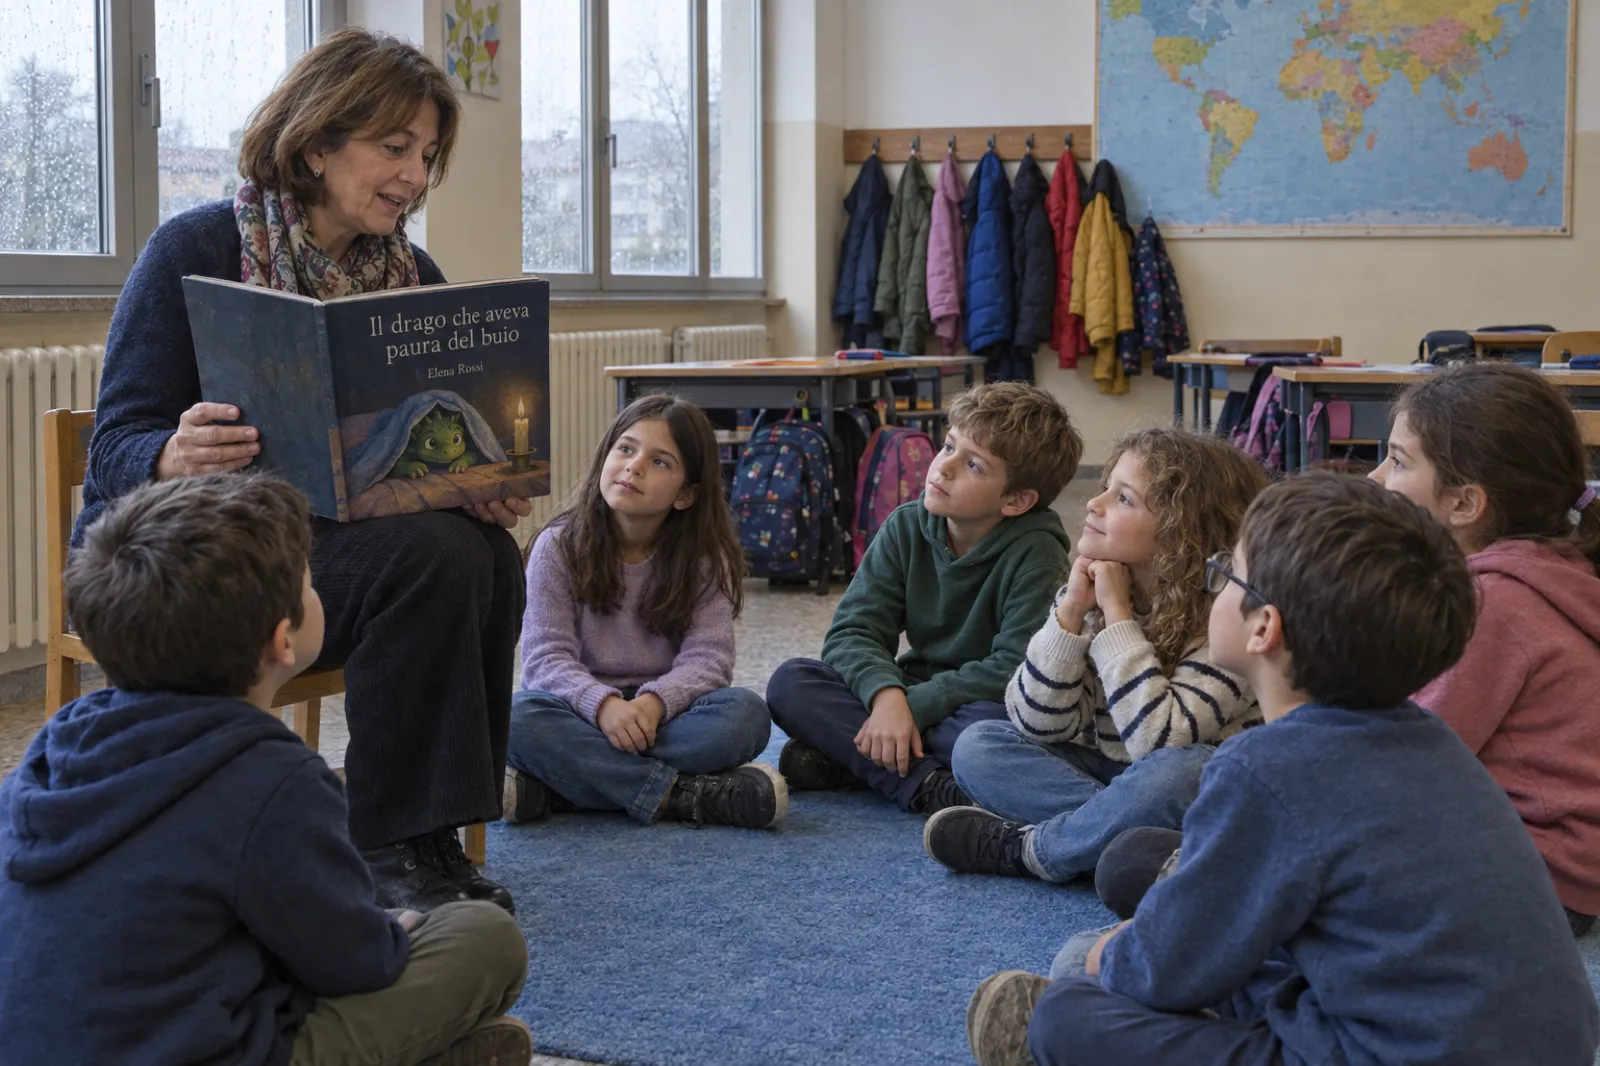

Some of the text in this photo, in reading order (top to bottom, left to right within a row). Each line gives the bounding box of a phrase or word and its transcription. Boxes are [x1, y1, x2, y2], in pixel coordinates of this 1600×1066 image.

[370, 305, 530, 337] Il drago che aveva
[386, 326, 520, 365] paura del buio
[427, 361, 484, 379] Elena Rossi
